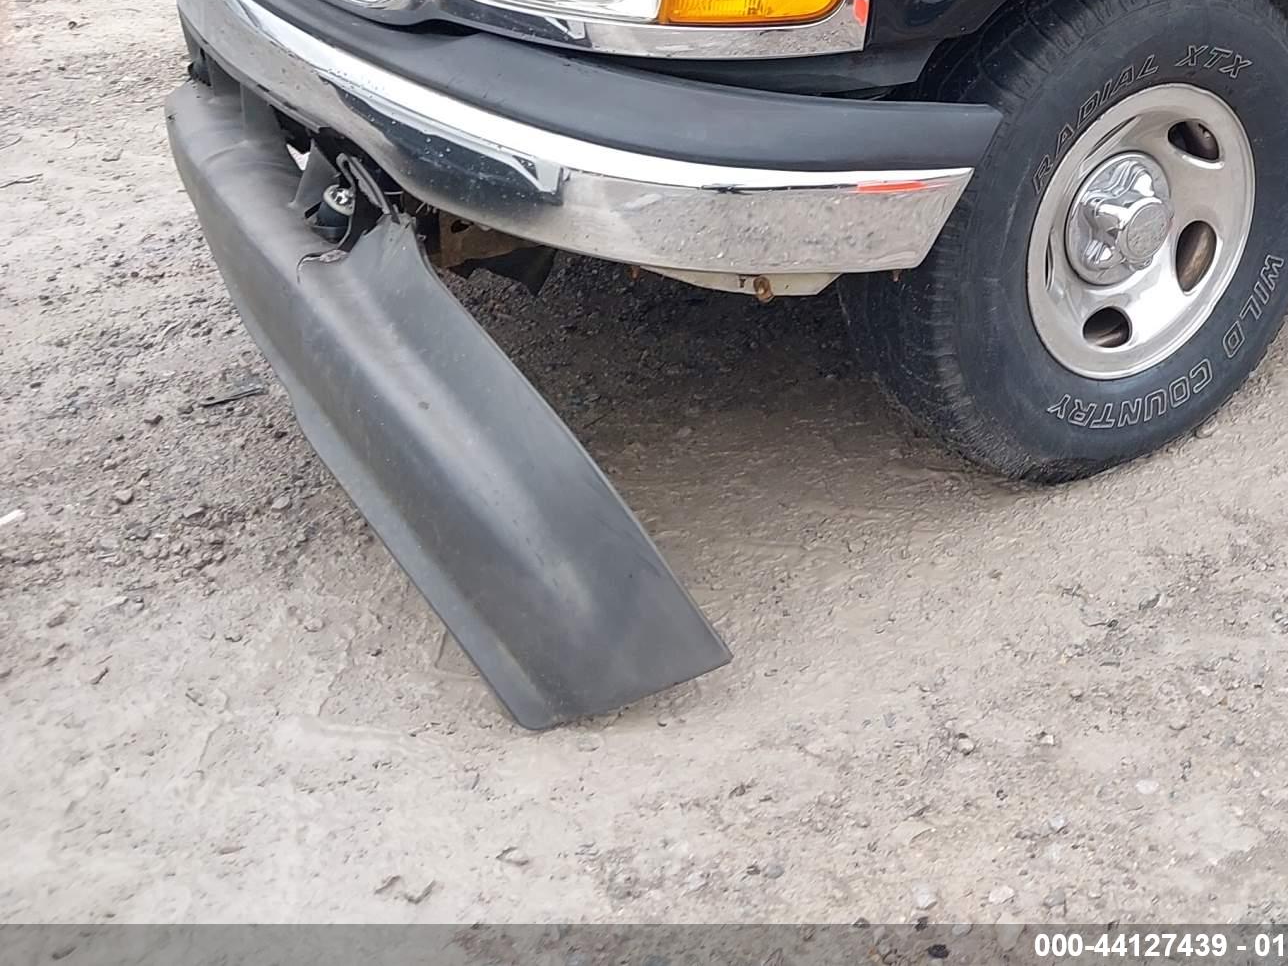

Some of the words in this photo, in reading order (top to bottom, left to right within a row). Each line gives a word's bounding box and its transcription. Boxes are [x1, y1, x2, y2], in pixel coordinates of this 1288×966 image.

[1031, 53, 1161, 195] RADIAL
[1174, 43, 1254, 79] XTX
[1221, 253, 1285, 360] WILD
[1046, 358, 1215, 430] COUNTRY
